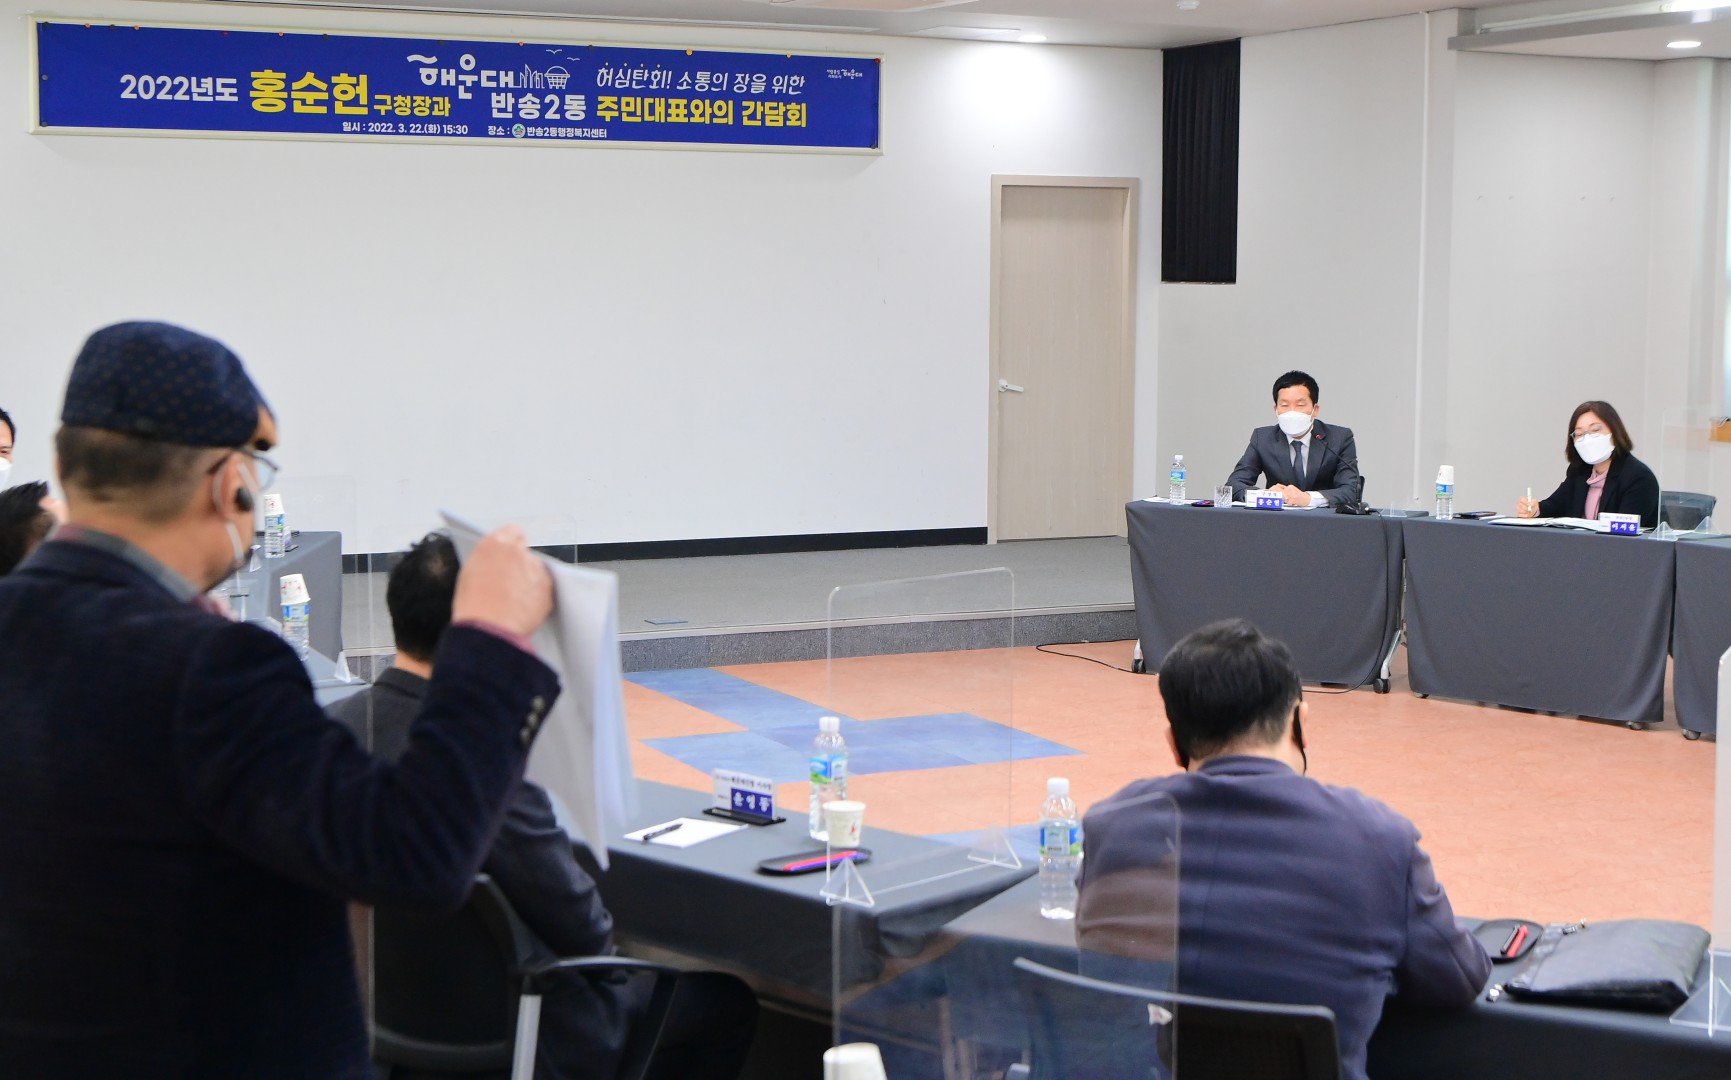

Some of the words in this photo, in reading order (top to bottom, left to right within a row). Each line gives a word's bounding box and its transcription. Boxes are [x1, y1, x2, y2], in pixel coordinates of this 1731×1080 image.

[406, 53, 514, 100] 해운대
[596, 66, 673, 90] 허심탄회!
[676, 71, 729, 92] 소통의
[733, 73, 767, 94] 장을
[771, 75, 806, 95] 위한
[119, 74, 239, 102] 2022년도
[249, 69, 369, 115] 홍순헌
[373, 94, 451, 117] 구청장과
[490, 92, 587, 121] 반송2동
[596, 95, 734, 125] 주민대표와의
[741, 101, 807, 128] 간담회
[342, 121, 360, 132] 일시
[367, 122, 396, 133] 2022.
[398, 123, 407, 133] 3.
[409, 123, 441, 135] 22.(화)
[442, 124, 468, 135] 15:30
[487, 125, 505, 136] 장소
[526, 126, 607, 138] 반송2동행정복지센터
